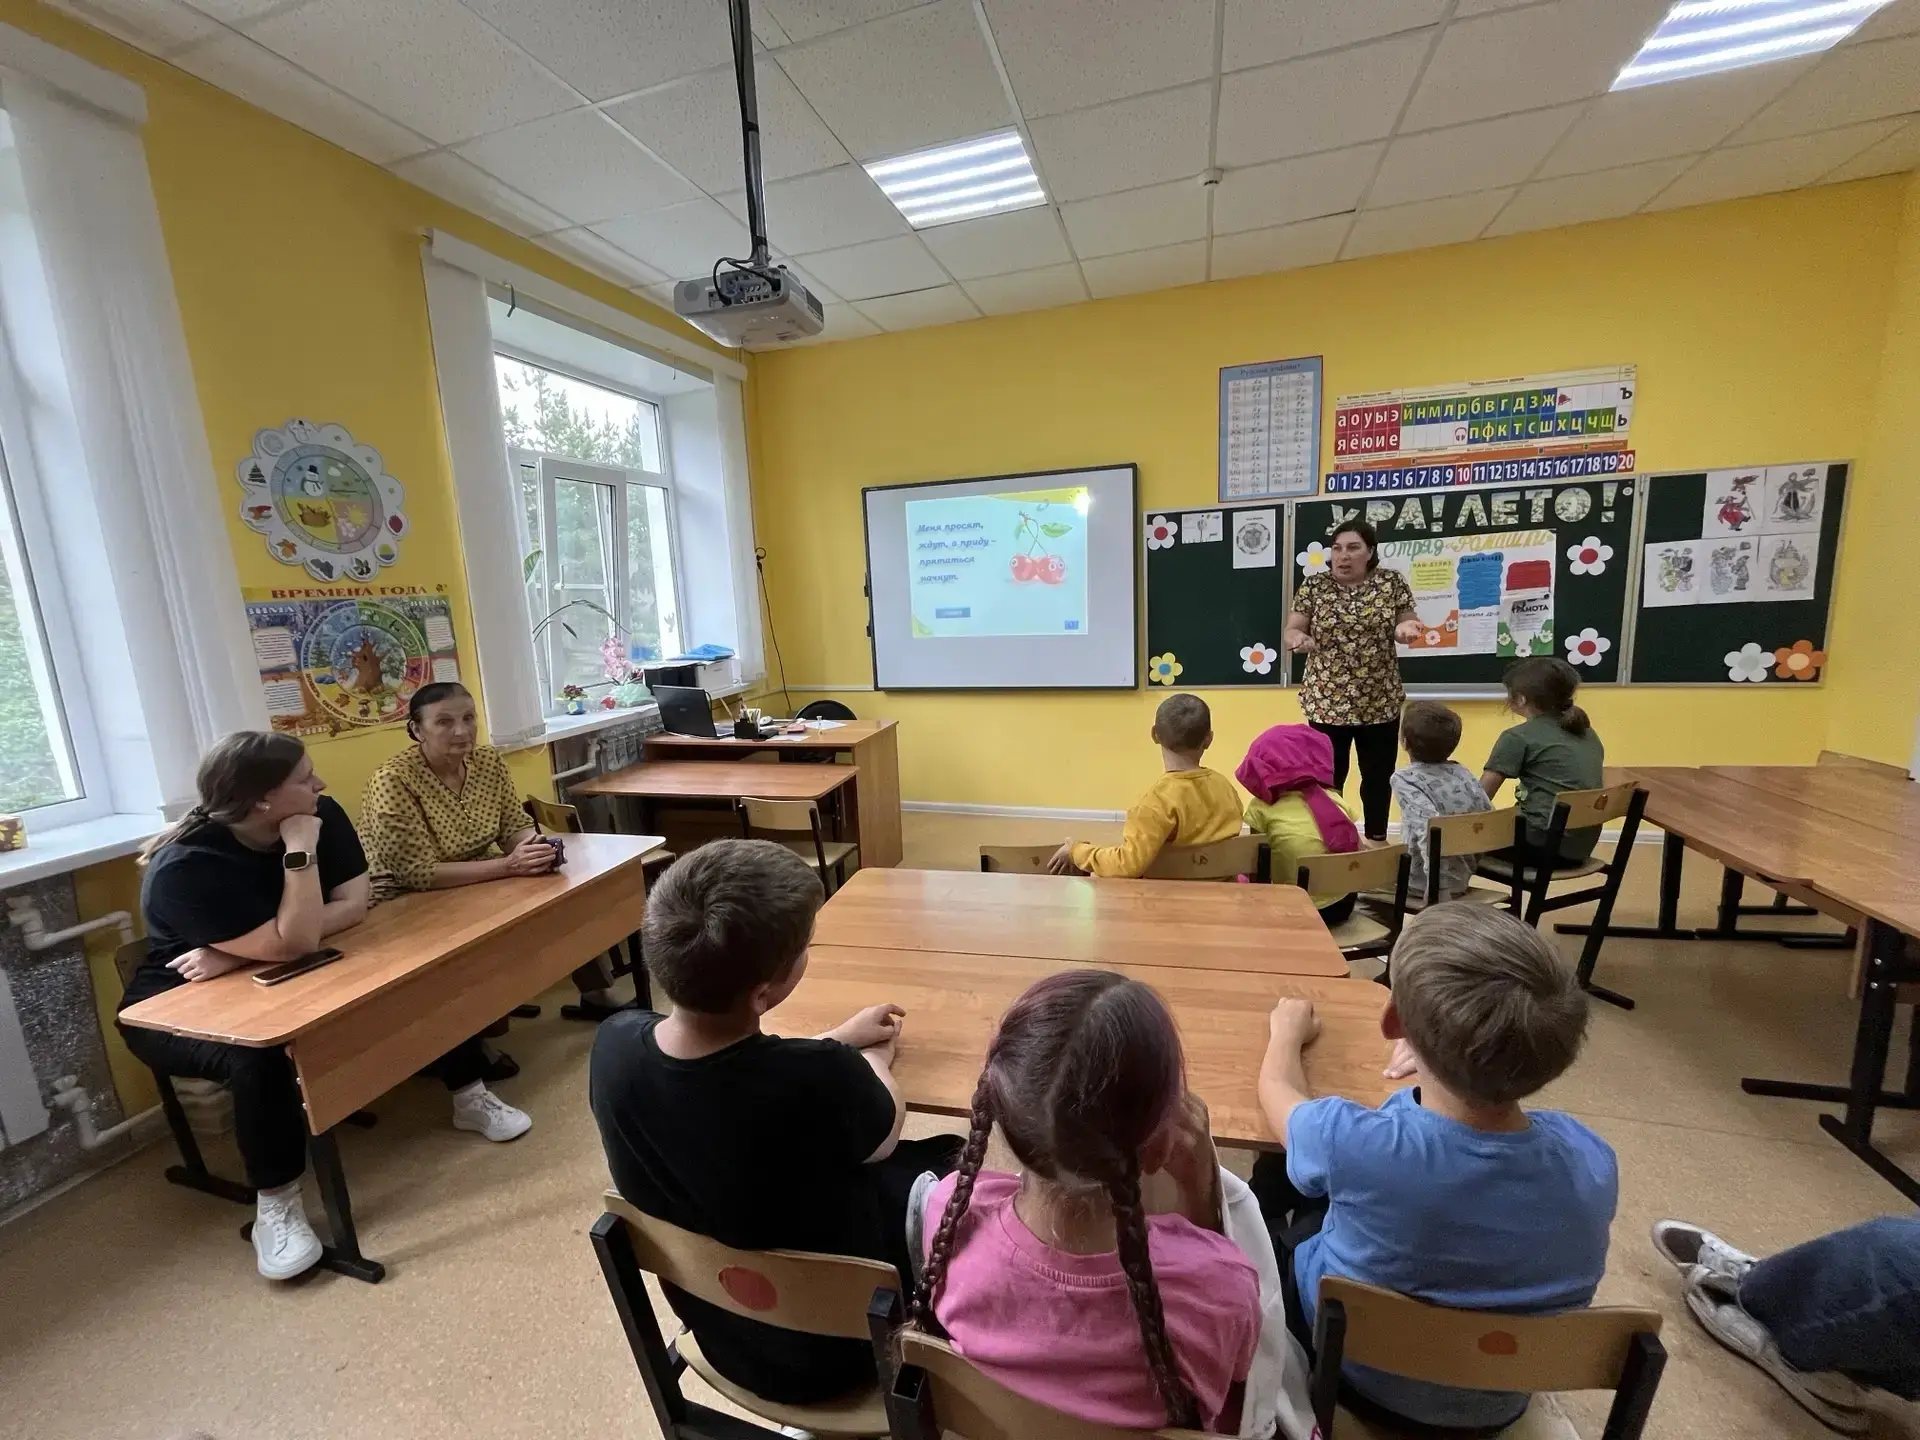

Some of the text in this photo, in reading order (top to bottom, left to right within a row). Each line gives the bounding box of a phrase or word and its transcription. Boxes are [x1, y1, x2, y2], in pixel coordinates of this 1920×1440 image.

[1328, 454, 1634, 490] 0 1 2 3 4 5 6 7 8 9 10 11 12 13 14 15 16 17 18 19 20
[918, 521, 984, 533] Меня просят,
[918, 540, 949, 551] ждут,
[960, 536, 990, 549] приду
[919, 556, 975, 567] прятаться
[271, 584, 428, 599] ВРЕМЕНА ГОДА
